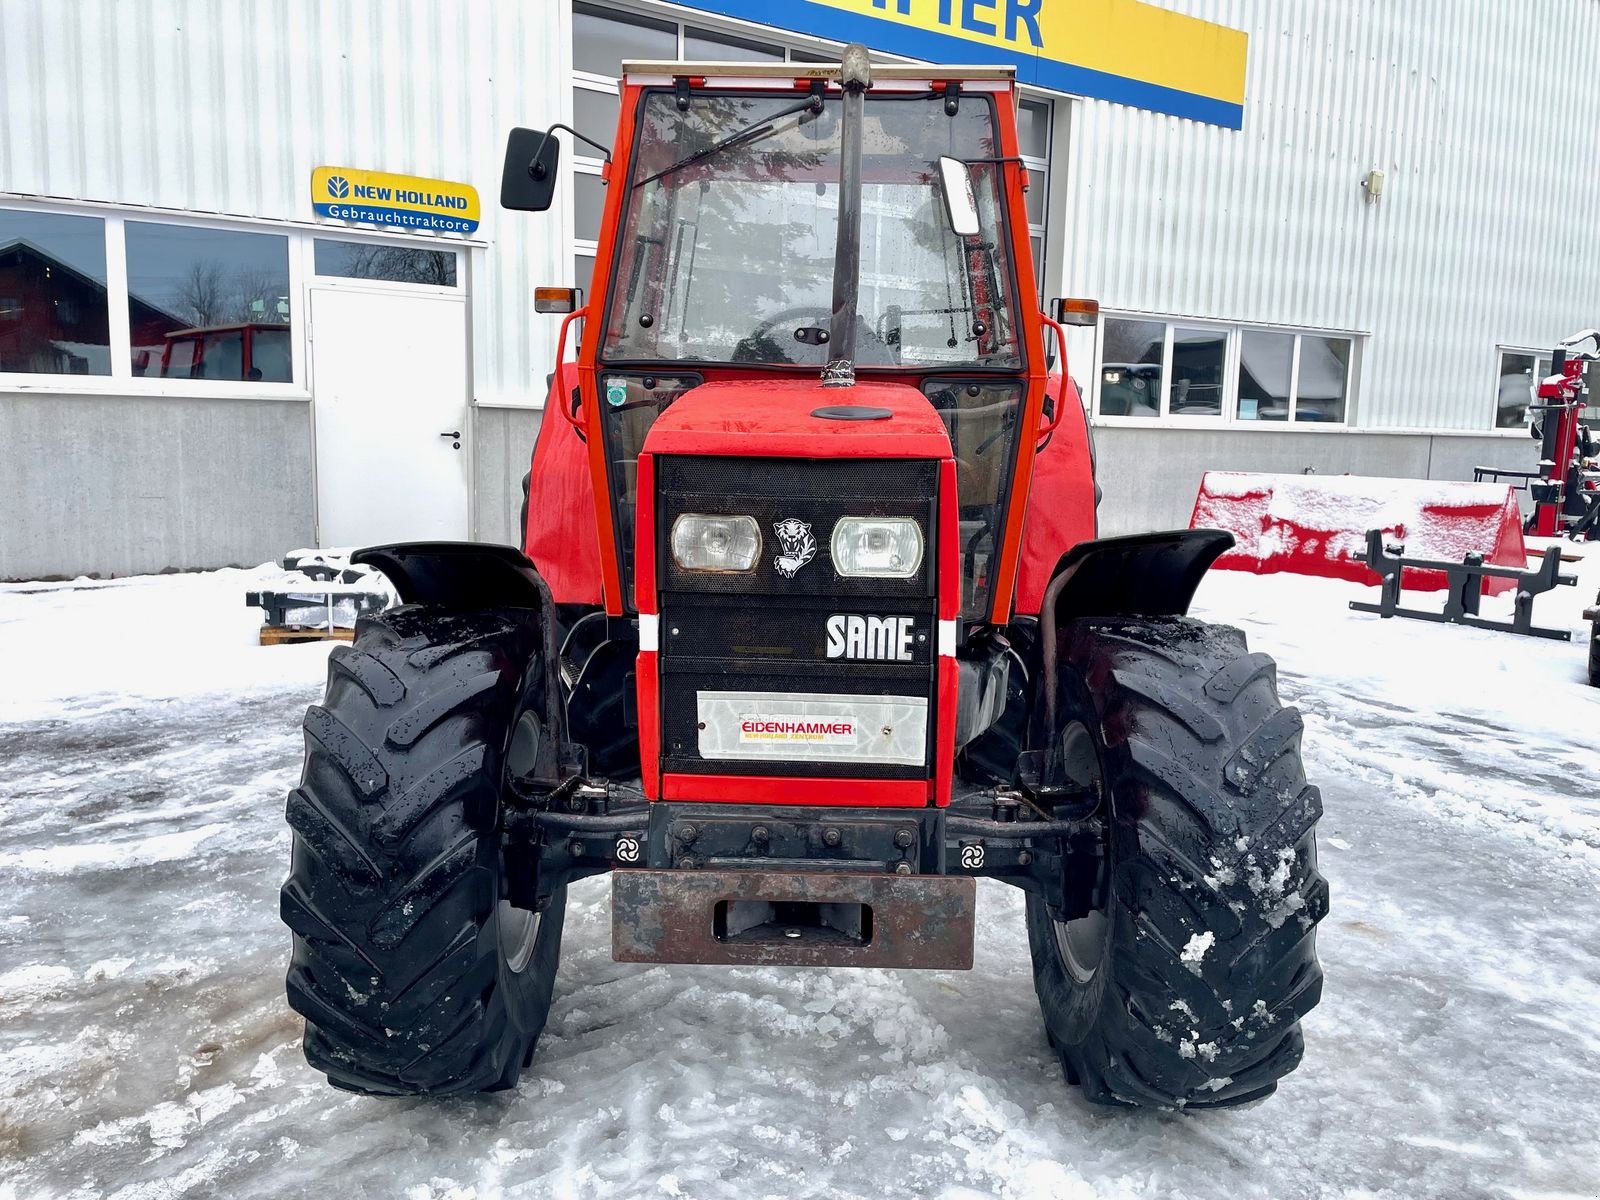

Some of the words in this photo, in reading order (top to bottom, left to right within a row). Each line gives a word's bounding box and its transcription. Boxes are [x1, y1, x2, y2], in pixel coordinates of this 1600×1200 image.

[354, 184, 391, 201] NEW
[395, 189, 468, 210] HOLLAND
[328, 205, 470, 231] Gebrauchttraktore
[826, 615, 914, 661] SAME
[741, 721, 853, 735] EIDENHAMMER
